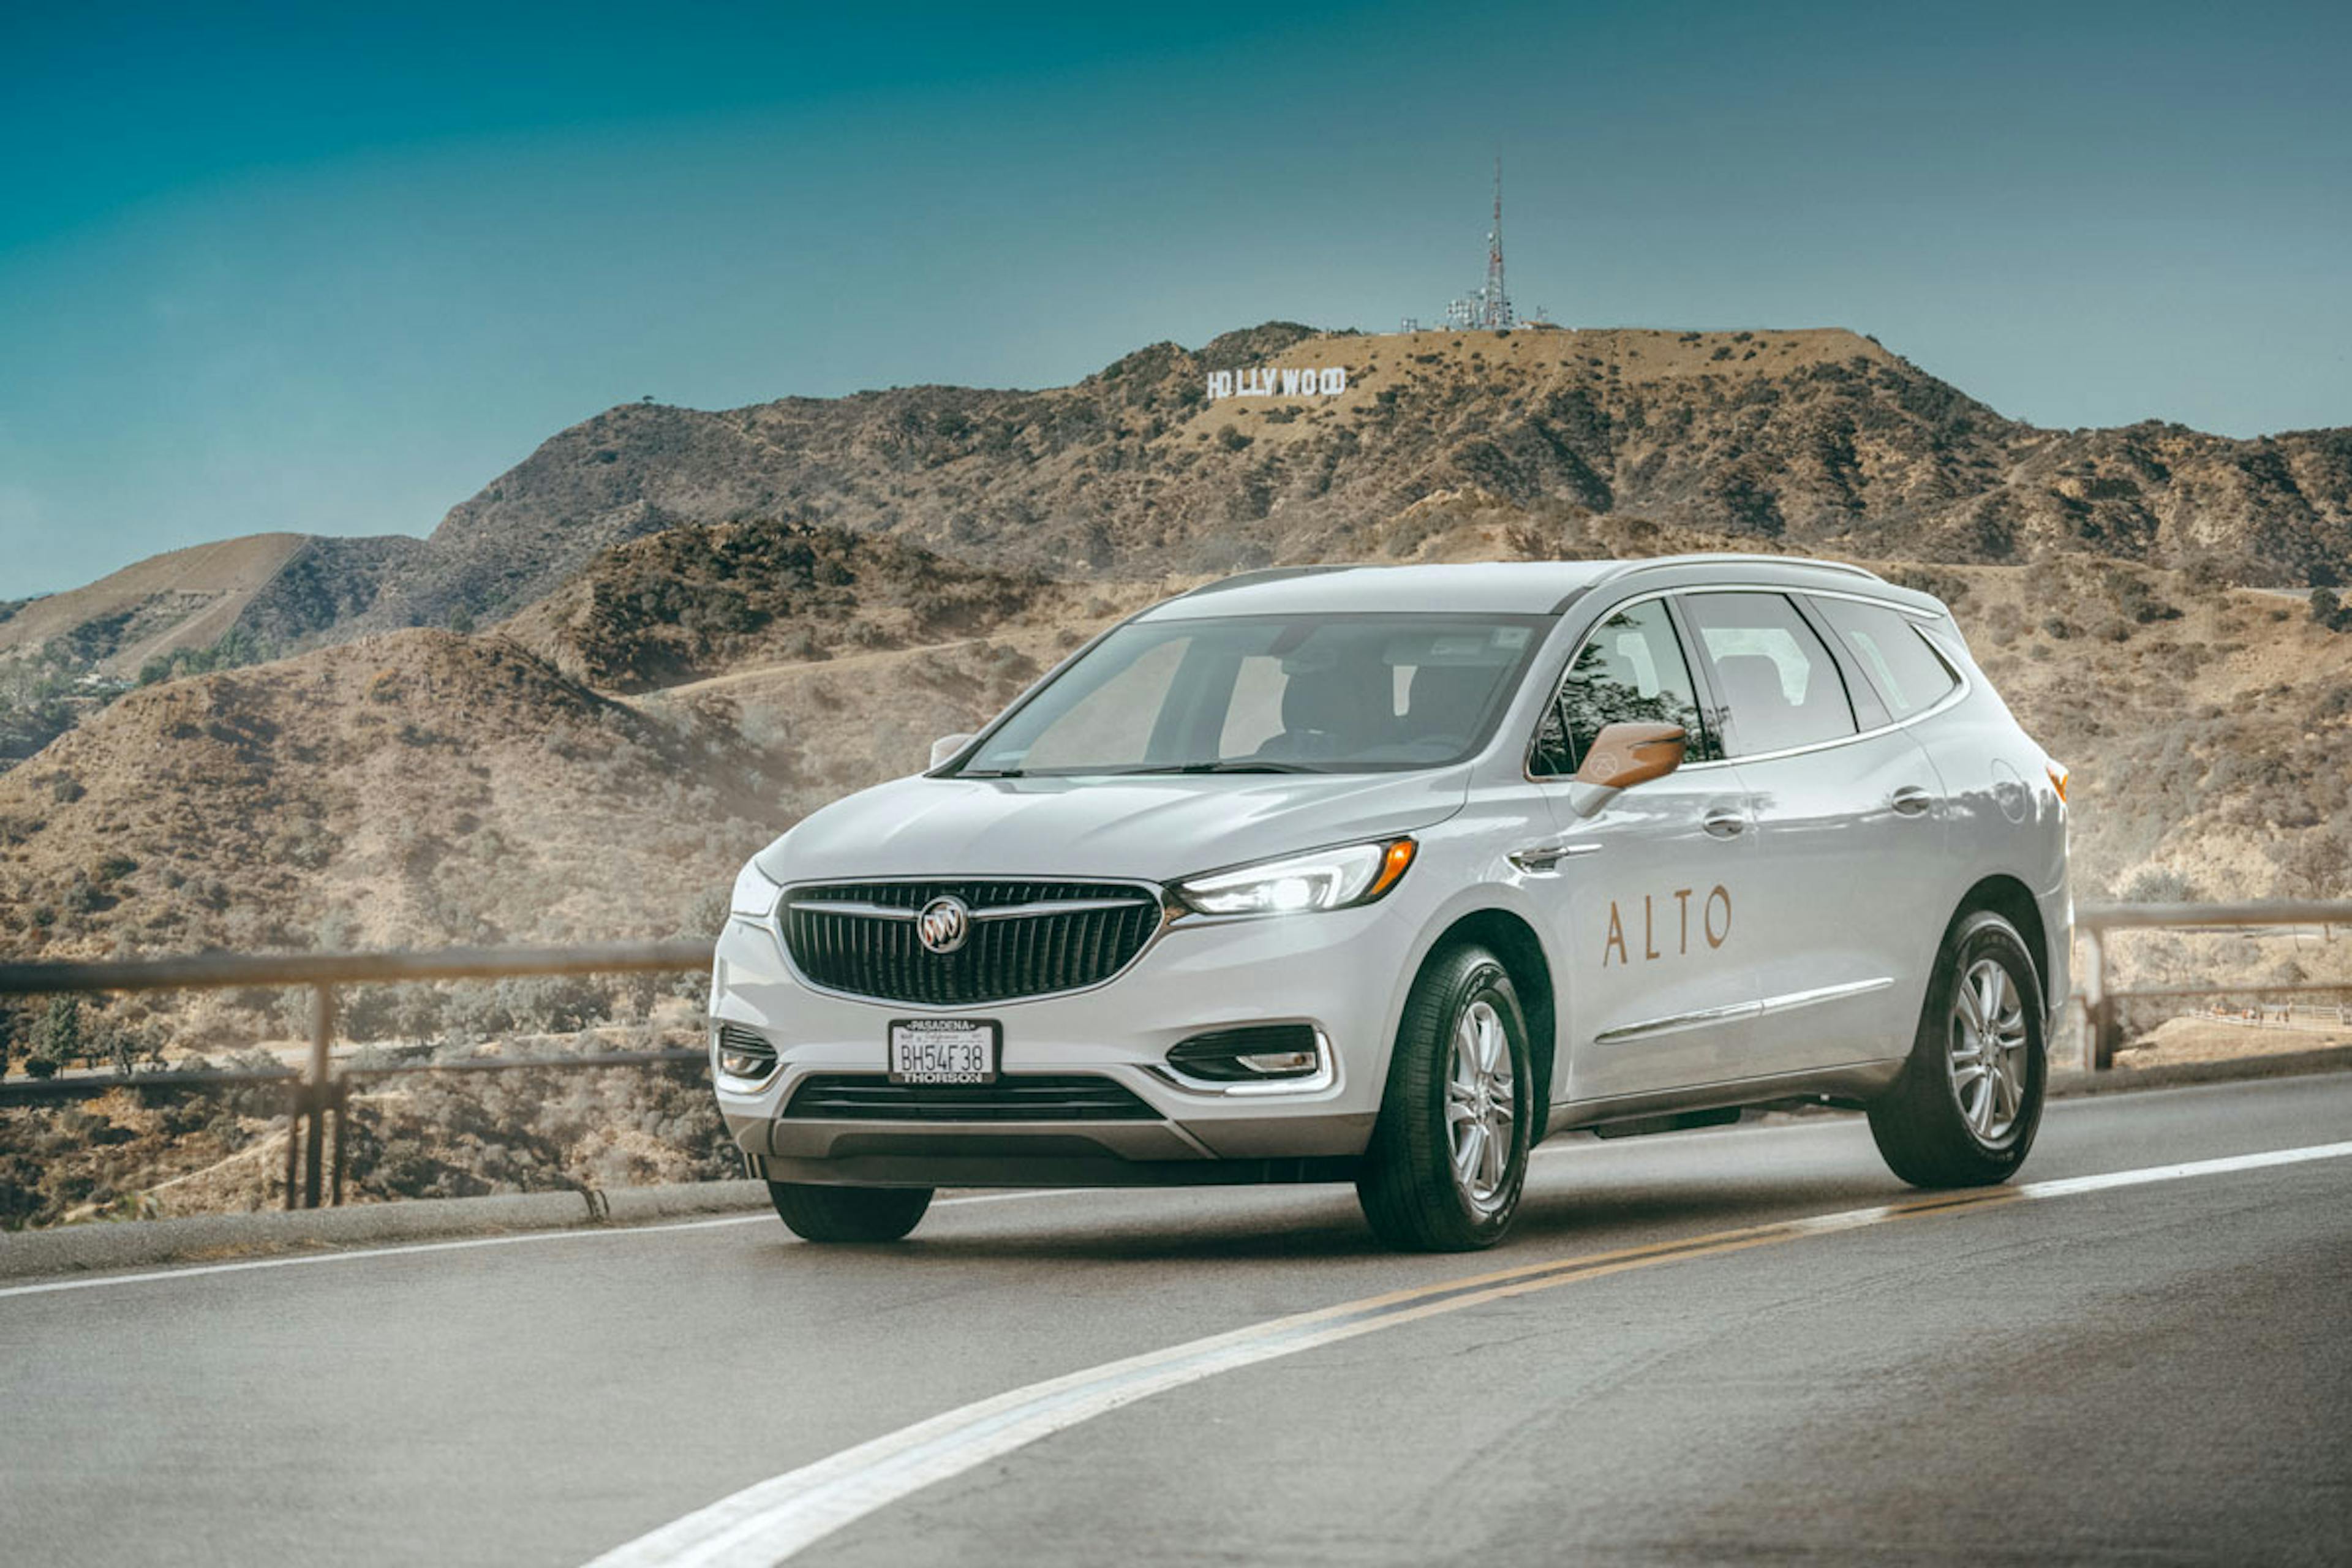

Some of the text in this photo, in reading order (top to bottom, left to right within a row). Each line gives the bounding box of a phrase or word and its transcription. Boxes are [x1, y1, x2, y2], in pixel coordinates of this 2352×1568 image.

[1207, 367, 1345, 399] HOLLYWOOD
[1603, 884, 1732, 967] ALTO
[911, 1020, 970, 1030] PASADENA
